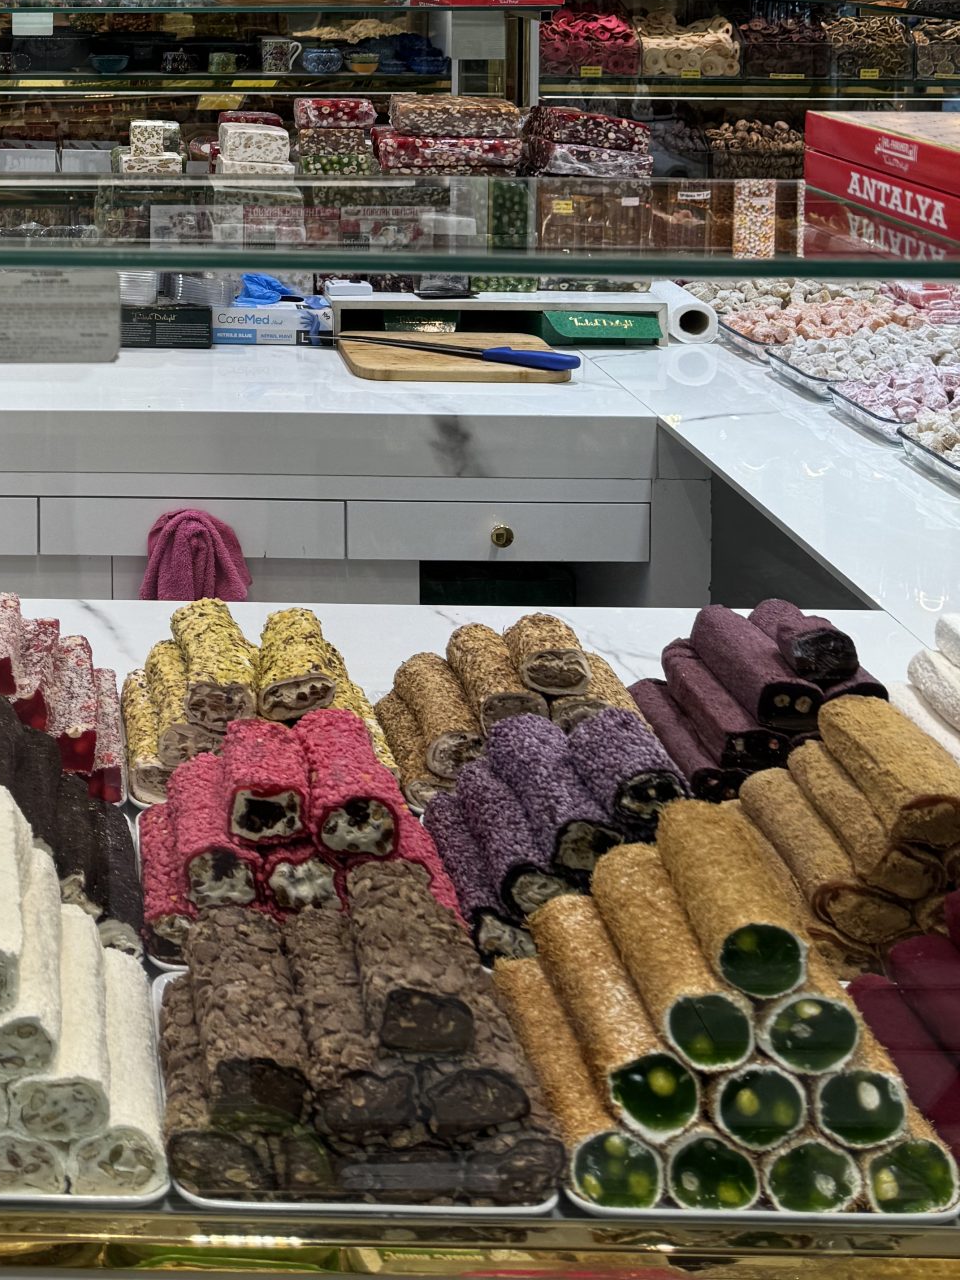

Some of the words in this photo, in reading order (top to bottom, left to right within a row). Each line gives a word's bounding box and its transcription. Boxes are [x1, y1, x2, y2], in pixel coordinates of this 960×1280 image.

[847, 171, 948, 231] ANTALYA
[217, 313, 270, 325] CoreMed
[568, 316, 600, 327] Turkish
[601, 318, 635, 329] Delight
[301, 332, 309, 343] L
